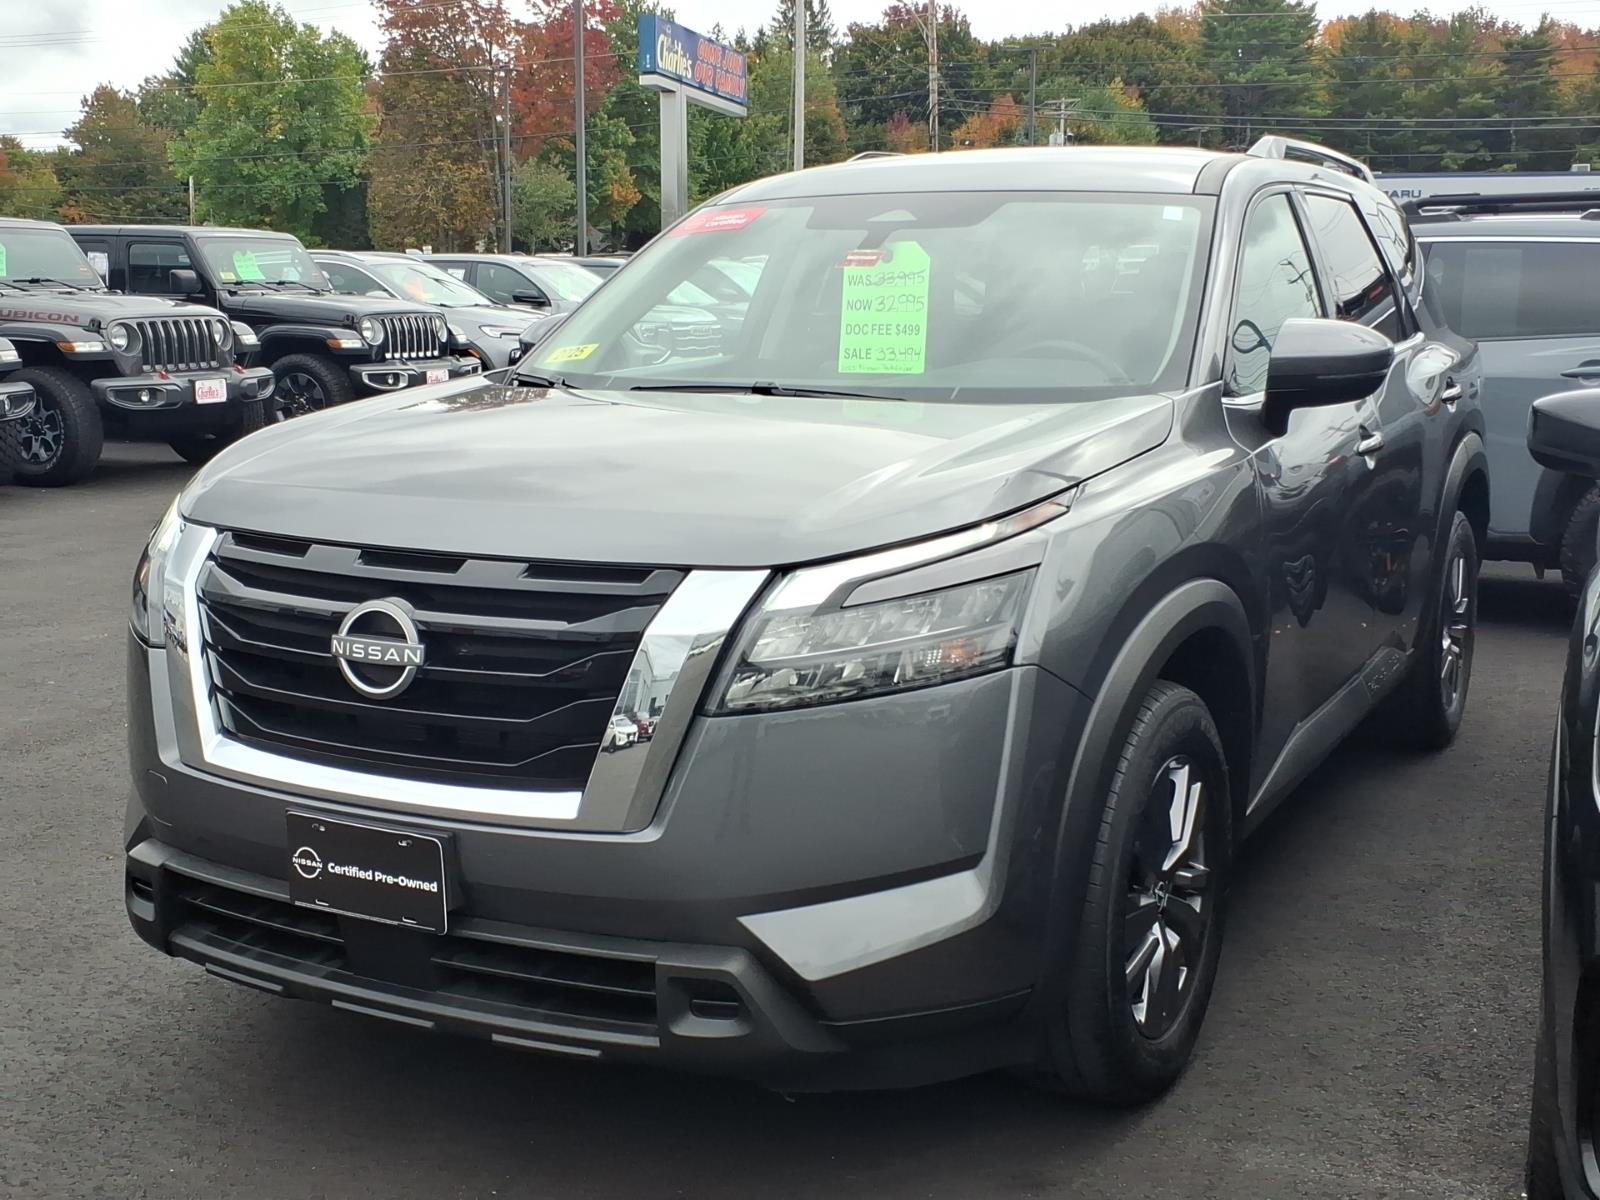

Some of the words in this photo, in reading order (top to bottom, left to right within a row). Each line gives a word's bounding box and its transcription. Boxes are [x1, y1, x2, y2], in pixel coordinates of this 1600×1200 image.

[658, 34, 692, 79] Charlie's
[694, 60, 714, 88] OUR
[1385, 189, 1422, 198] ARU
[847, 274, 872, 287] WAS
[846, 298, 872, 312] NOW
[845, 323, 869, 336] DOC
[871, 323, 893, 336] FEE
[895, 323, 920, 336] $499
[843, 347, 872, 360] SALE
[331, 639, 421, 663] NISSAN
[292, 856, 323, 868] NISSAN
[327, 862, 373, 880] Certified
[374, 871, 438, 892] Pre-Owned
